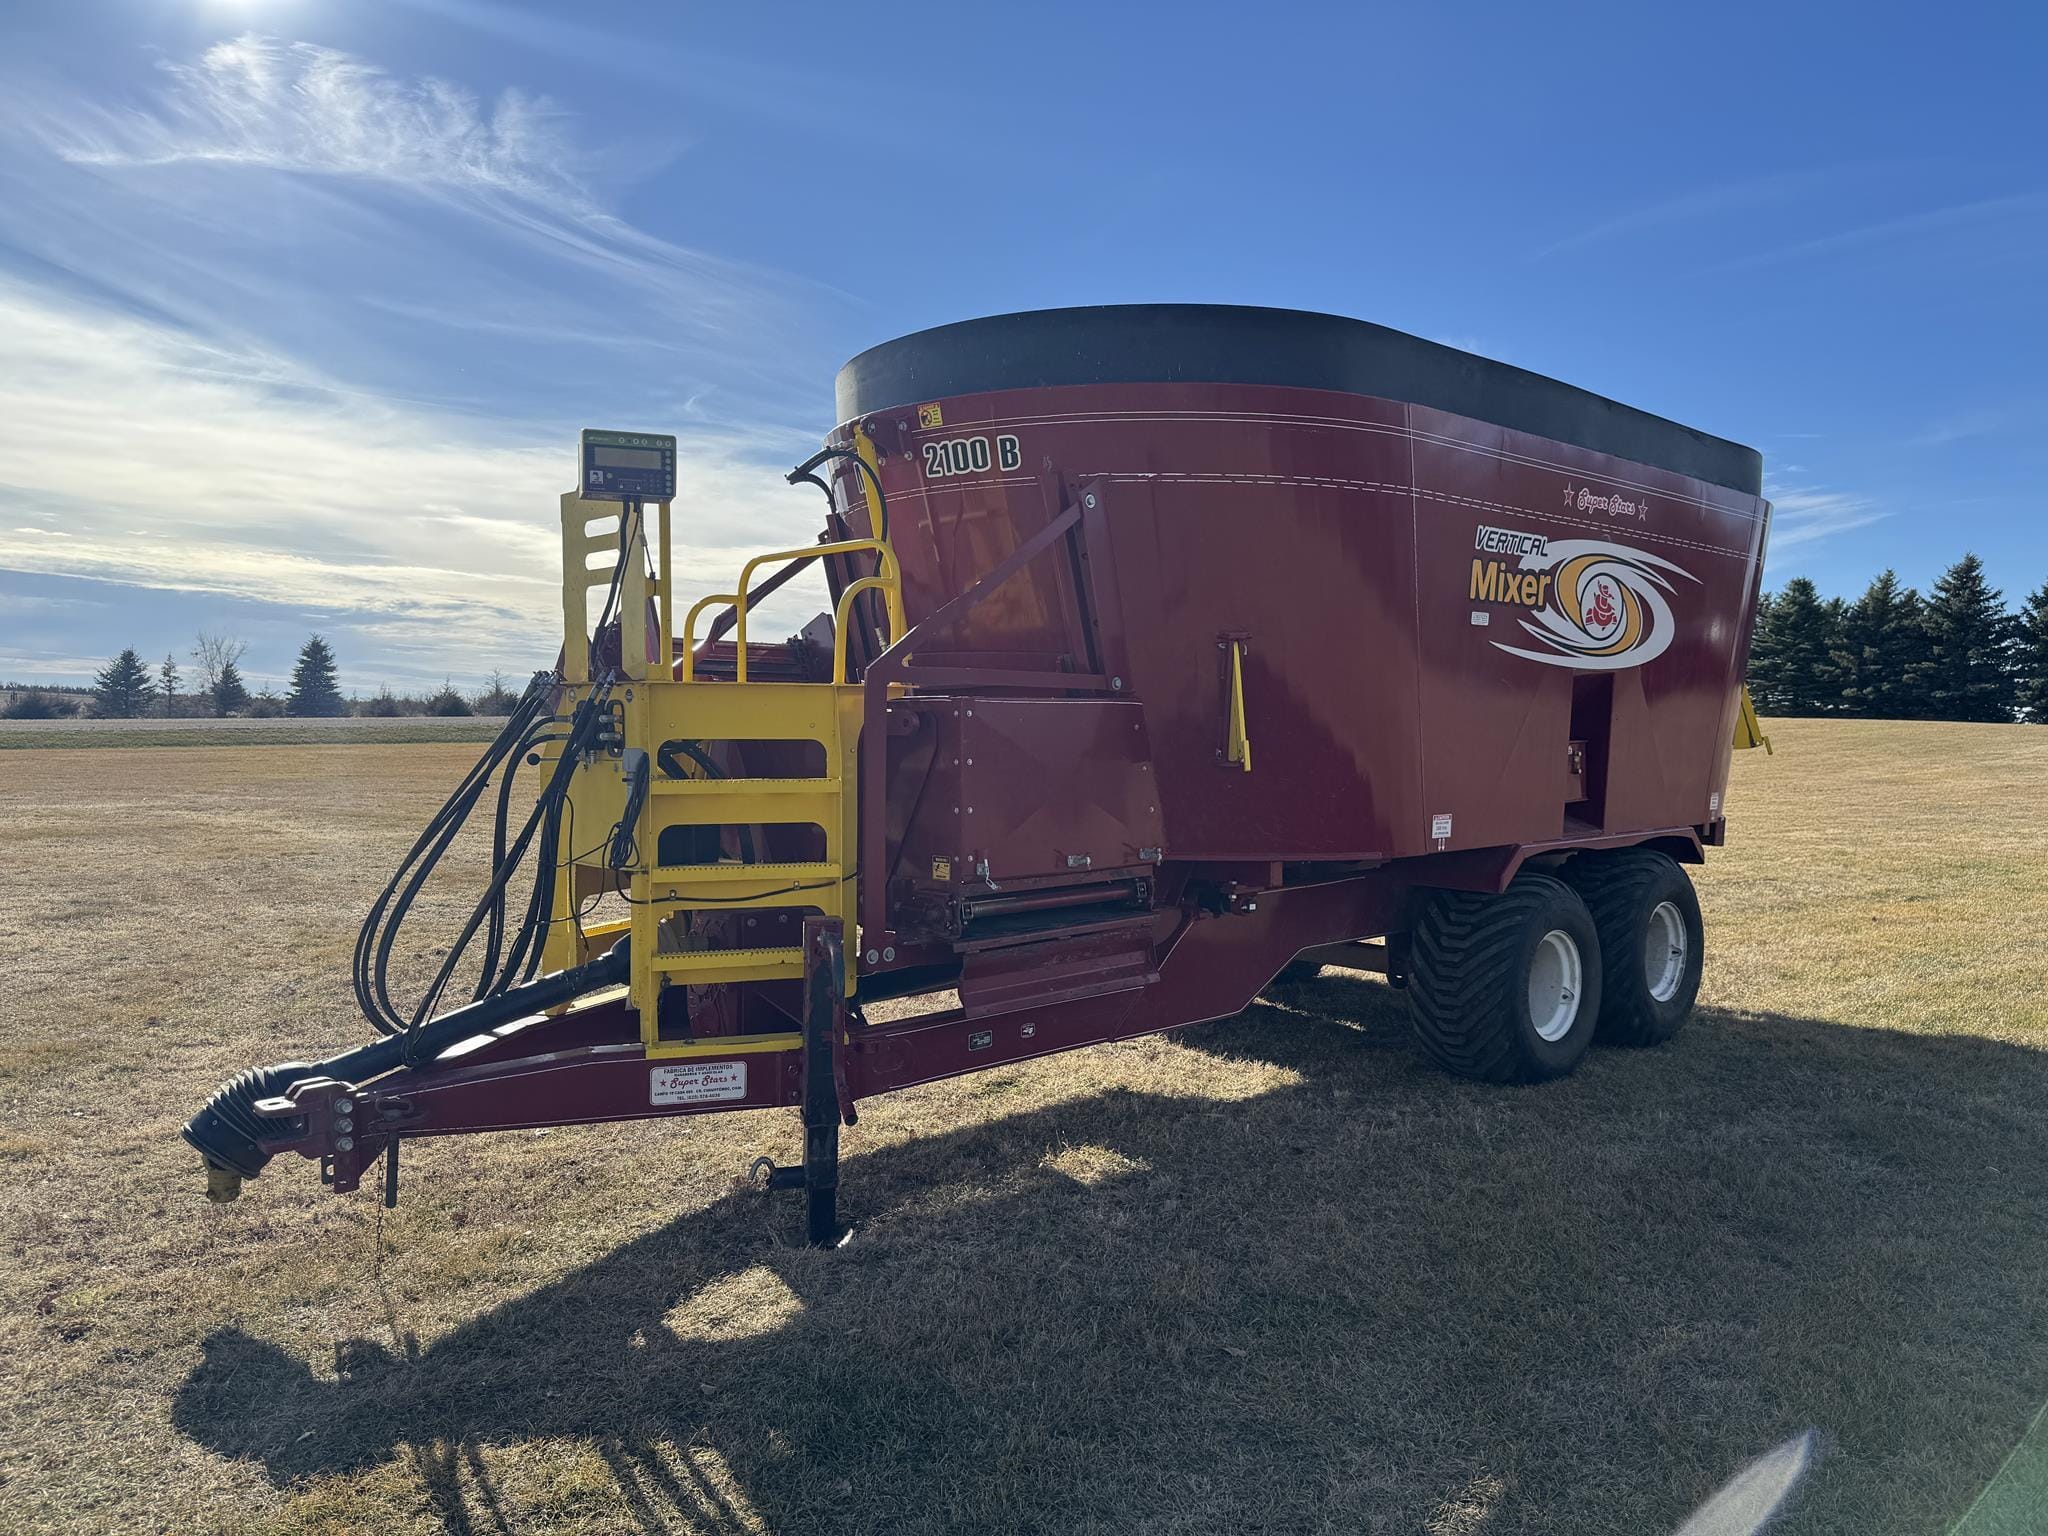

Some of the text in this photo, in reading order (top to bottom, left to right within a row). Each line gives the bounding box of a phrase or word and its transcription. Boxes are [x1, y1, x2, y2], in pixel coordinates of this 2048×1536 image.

[923, 435, 1021, 477] 2100 B
[1577, 488, 1636, 516] Super Stars
[1475, 525, 1548, 557] VERTICAL
[1470, 559, 1551, 606] Mixer
[670, 1075, 728, 1089] Super Stars
